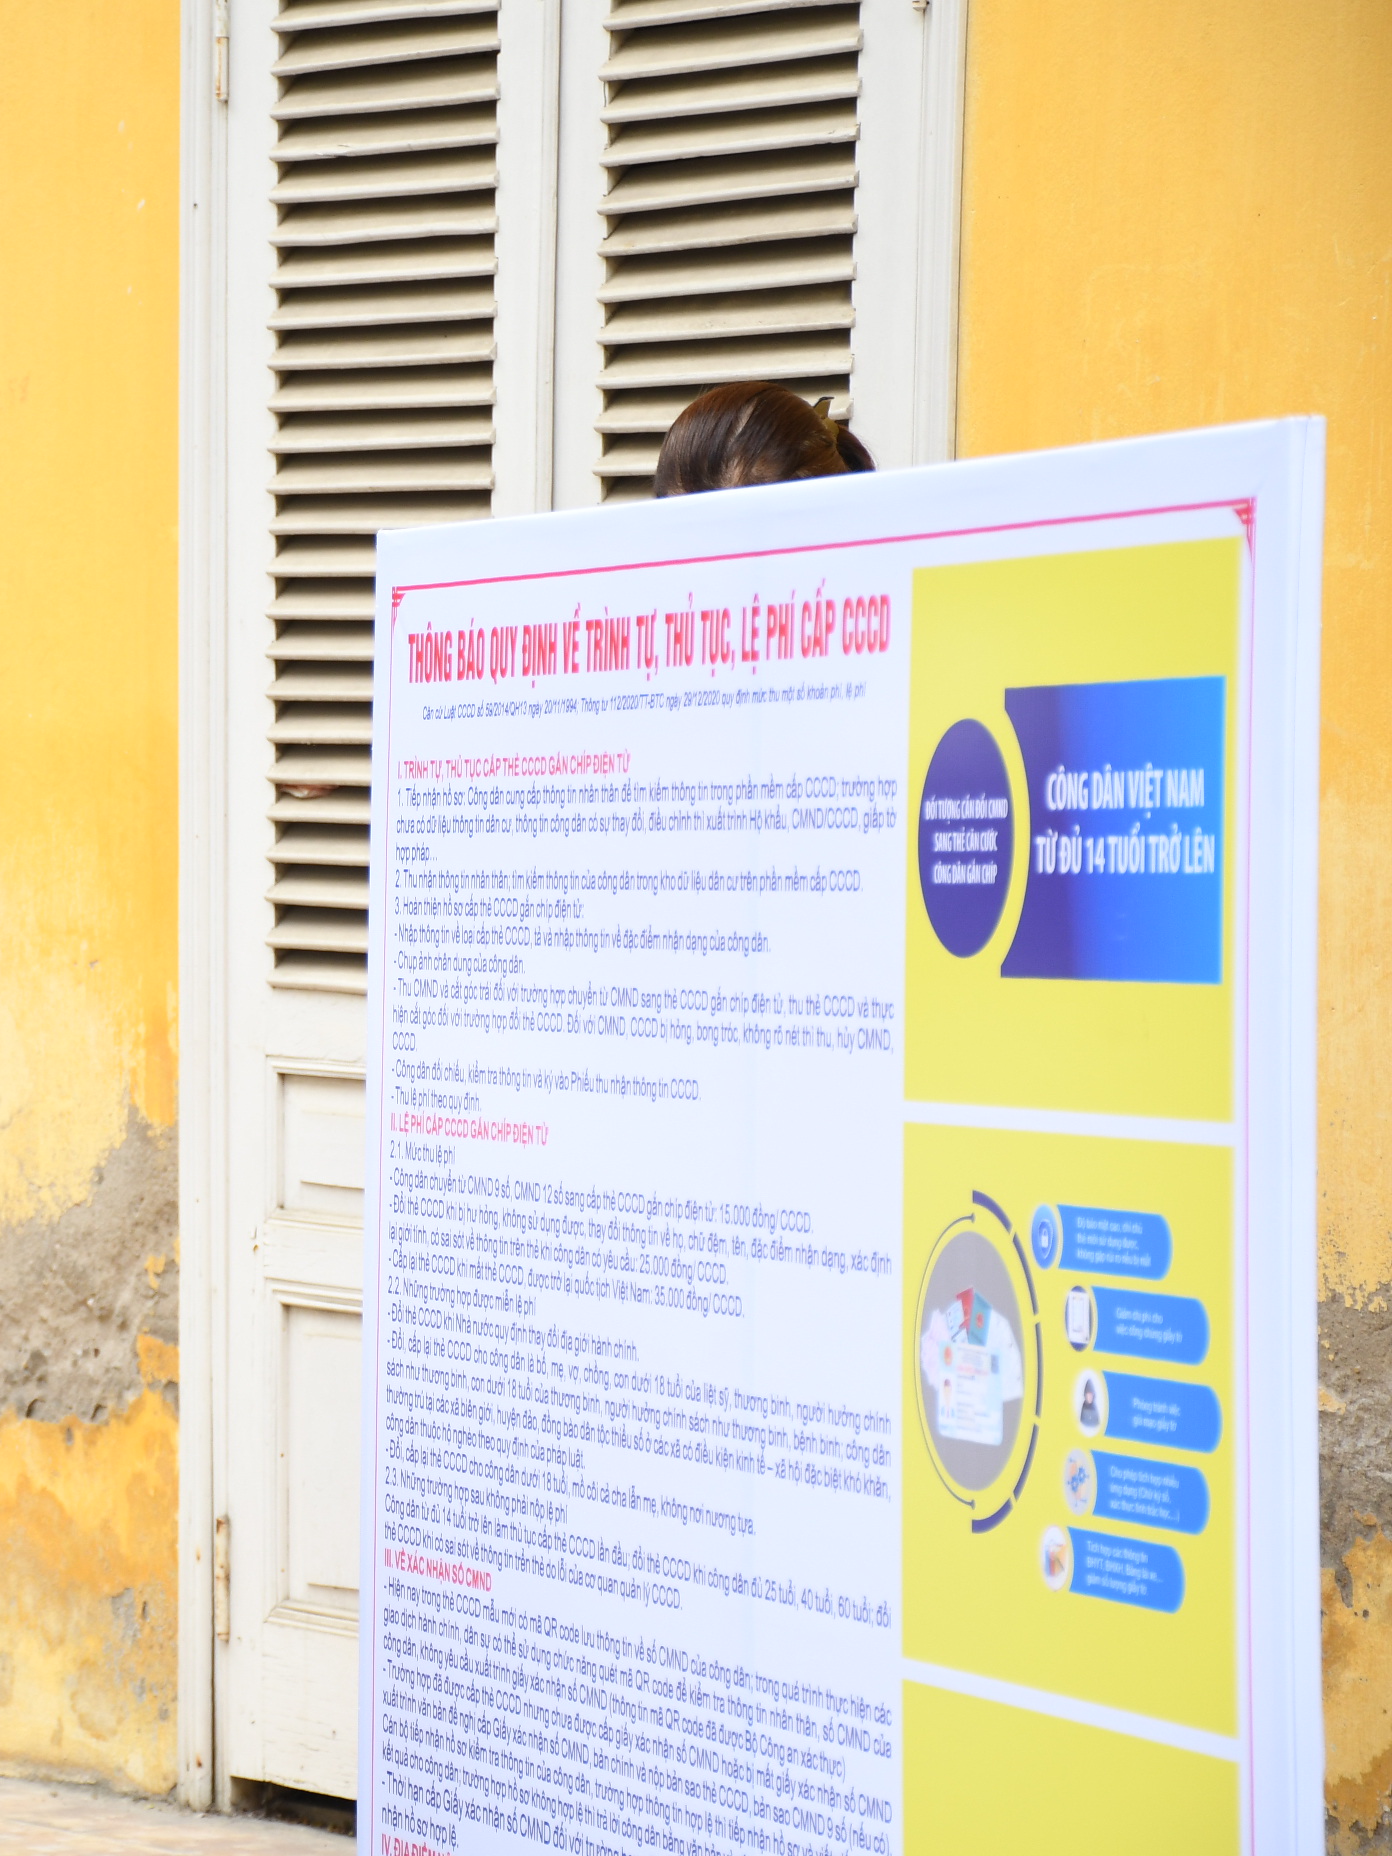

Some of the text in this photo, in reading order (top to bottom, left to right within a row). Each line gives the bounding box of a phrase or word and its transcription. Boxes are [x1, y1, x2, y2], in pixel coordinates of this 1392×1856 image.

[408, 578, 891, 689] THÔNG BÁO QUY ĐỊNH VỀ TRÌNH TỰ, THỦ TỤC, LỆ PHÍ CẤP CCCD
[458, 703, 476, 718] CCCD
[397, 748, 631, 783] I. TRÌNH TỰ, THỦ TỤC CẤP THẺ CCCD GẮN CHÍP ĐIỆN TỬ
[1047, 761, 1204, 819] CÔNG DÂN VIỆT NAM
[1035, 821, 1215, 874] TỪ ĐỦ 14 TUỔI TRỞ LÊN
[399, 1111, 409, 1137] LỆ
[410, 1110, 425, 1134] PHÍ
[426, 1113, 443, 1135] CẤP
[444, 1118, 468, 1138] CCCD
[470, 1117, 489, 1140] GẮN
[491, 1118, 512, 1141] CHÍP
[513, 1122, 534, 1148] ĐIỆN
[536, 1122, 549, 1145] TỬ
[405, 1142, 422, 1162] Mức
[422, 1144, 434, 1163] thu
[435, 1145, 442, 1168] lệ
[403, 1278, 428, 1303] Những
[429, 1282, 455, 1308] trường
[456, 1286, 471, 1309] hợp
[473, 1288, 494, 1311] được
[495, 1289, 514, 1312] miễn
[515, 1293, 522, 1319] lệ
[400, 1468, 425, 1497] Những
[427, 1474, 453, 1502] trường
[454, 1479, 469, 1507] hợp
[471, 1487, 485, 1505] sau
[486, 1488, 510, 1515] không
[511, 1492, 529, 1517] phải
[529, 1496, 545, 1521] nộp
[547, 1498, 554, 1524] lệ
[407, 1549, 425, 1576] XÁC
[426, 1558, 451, 1584] NHẬN
[452, 1561, 464, 1587] SỐ
[465, 1569, 492, 1592] CMND
[382, 1803, 403, 1830] nhận
[404, 1805, 415, 1832] hồ
[416, 1816, 428, 1835] sơ
[430, 1817, 448, 1846] hợp
